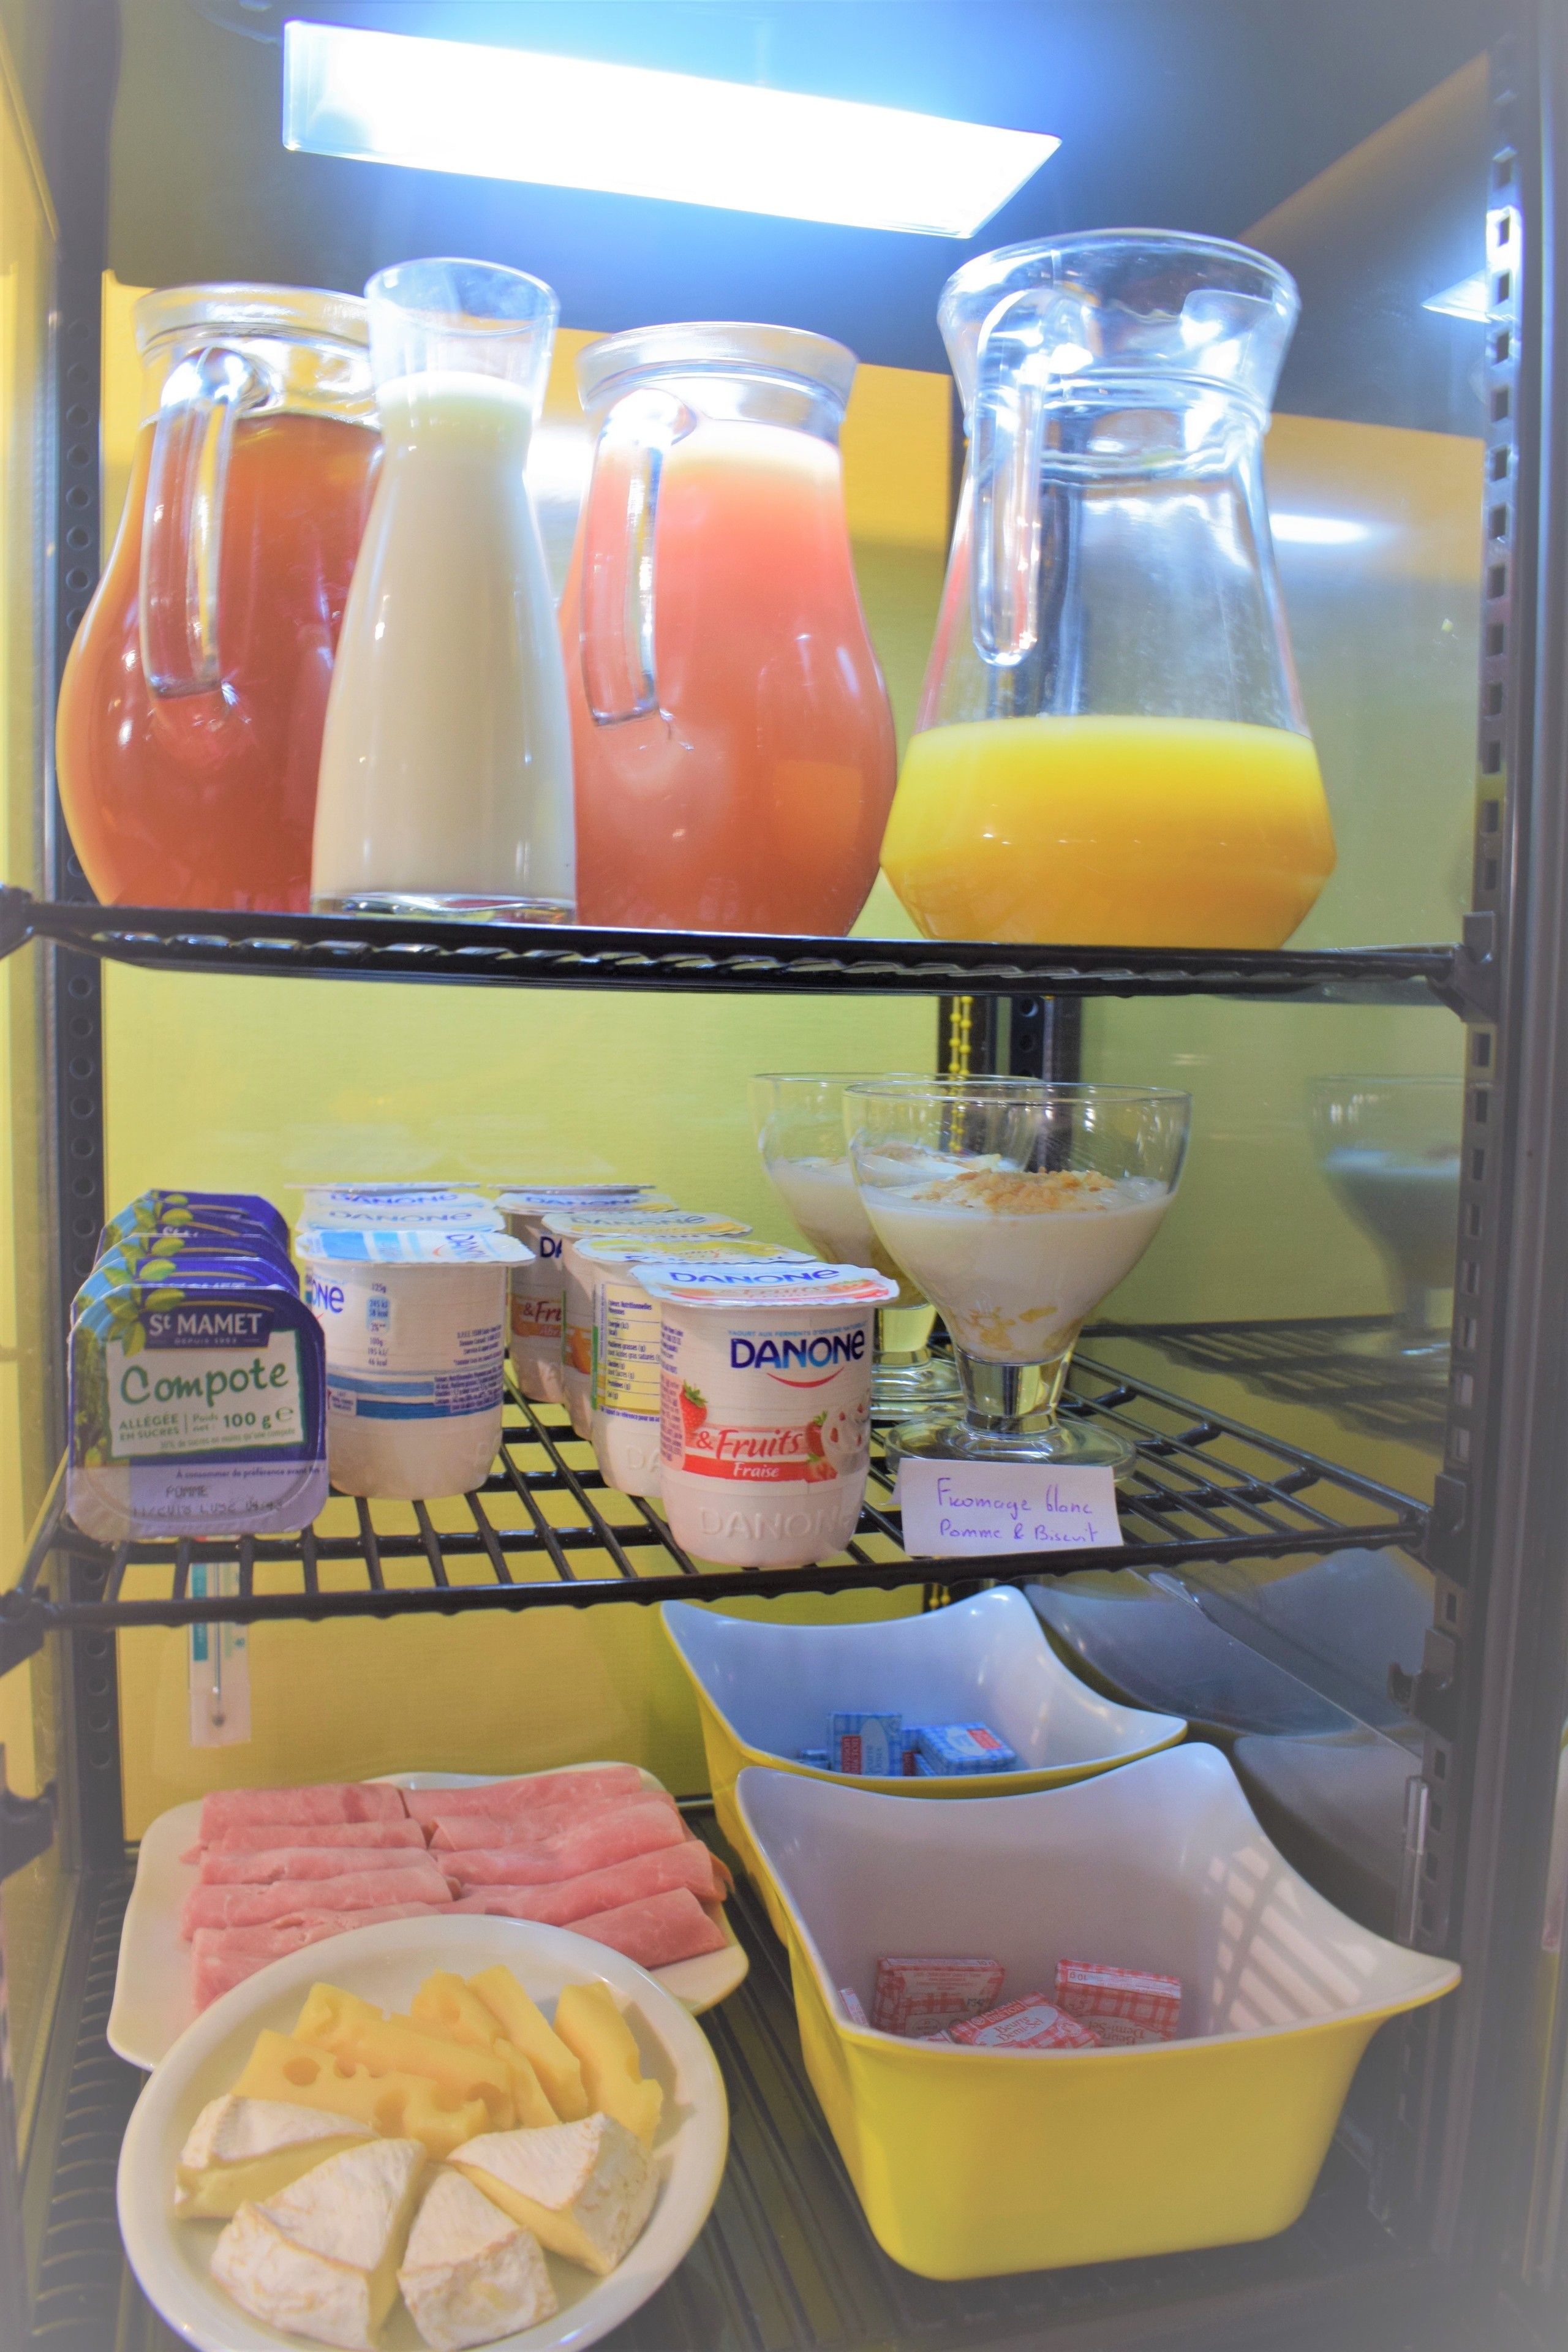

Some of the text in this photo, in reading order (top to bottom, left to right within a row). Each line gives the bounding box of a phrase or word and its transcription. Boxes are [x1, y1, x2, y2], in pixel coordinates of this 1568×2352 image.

[668, 1268, 840, 1284] DANONE
[149, 1312, 263, 1336] St MAMET
[730, 1330, 865, 1369] DANONE
[121, 1358, 289, 1407] Compote
[224, 1411, 257, 1428] 100
[262, 1415, 271, 1429] g
[696, 1428, 802, 1460] & Fruits
[733, 1461, 779, 1479] Fraise
[937, 1477, 1093, 1520] Fromage blanc
[940, 1518, 1099, 1543] Pomme & Biscuit
[994, 2015, 1031, 2034] Beurre
[997, 2018, 1044, 2041] Demi-Sel
